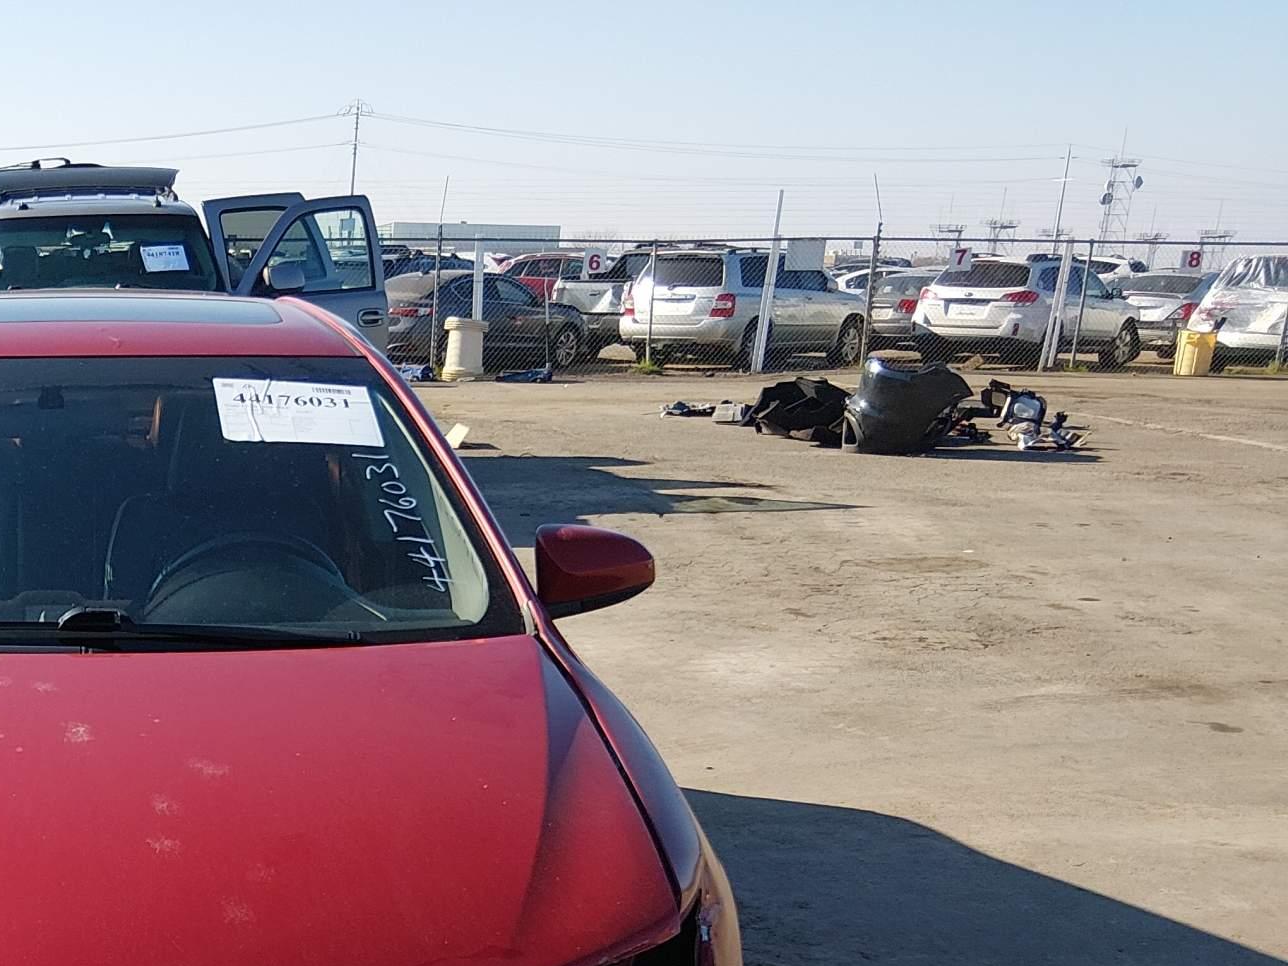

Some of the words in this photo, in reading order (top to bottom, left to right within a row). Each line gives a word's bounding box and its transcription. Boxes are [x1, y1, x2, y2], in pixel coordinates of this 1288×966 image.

[588, 254, 601, 271] 6
[955, 249, 968, 265] 7
[1188, 251, 1201, 268] 8
[233, 393, 350, 409] 44176031
[352, 453, 454, 592] 44176031
